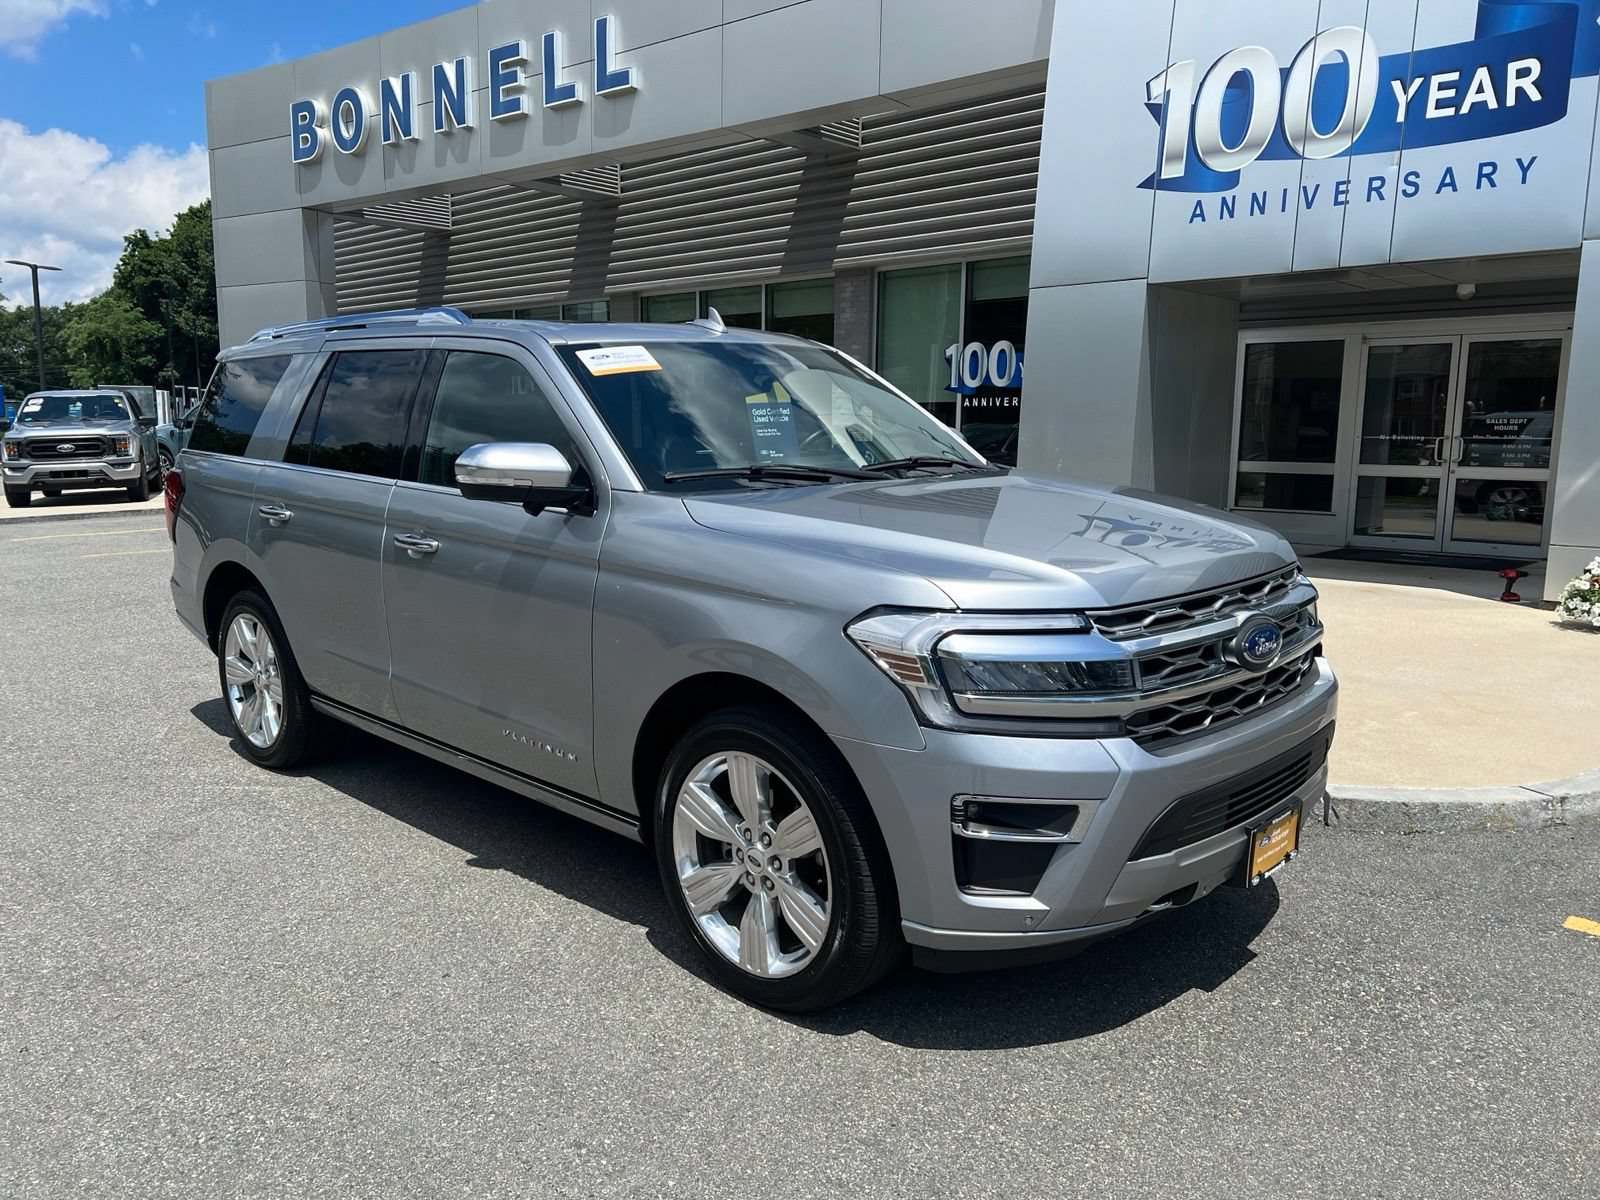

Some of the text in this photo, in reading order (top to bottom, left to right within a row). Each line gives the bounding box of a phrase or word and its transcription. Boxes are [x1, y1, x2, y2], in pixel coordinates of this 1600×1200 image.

[290, 14, 638, 164] BONNELL
[1146, 25, 1543, 180] 100 YEAR
[1189, 156, 1538, 224] ANNIVERSARY
[945, 340, 1017, 388] 100
[752, 408, 767, 416] Gold
[963, 397, 1019, 407] ANNIVER
[753, 415, 769, 423] Used
[1254, 632, 1278, 656] Ford
[502, 729, 578, 762] PLATINUM
